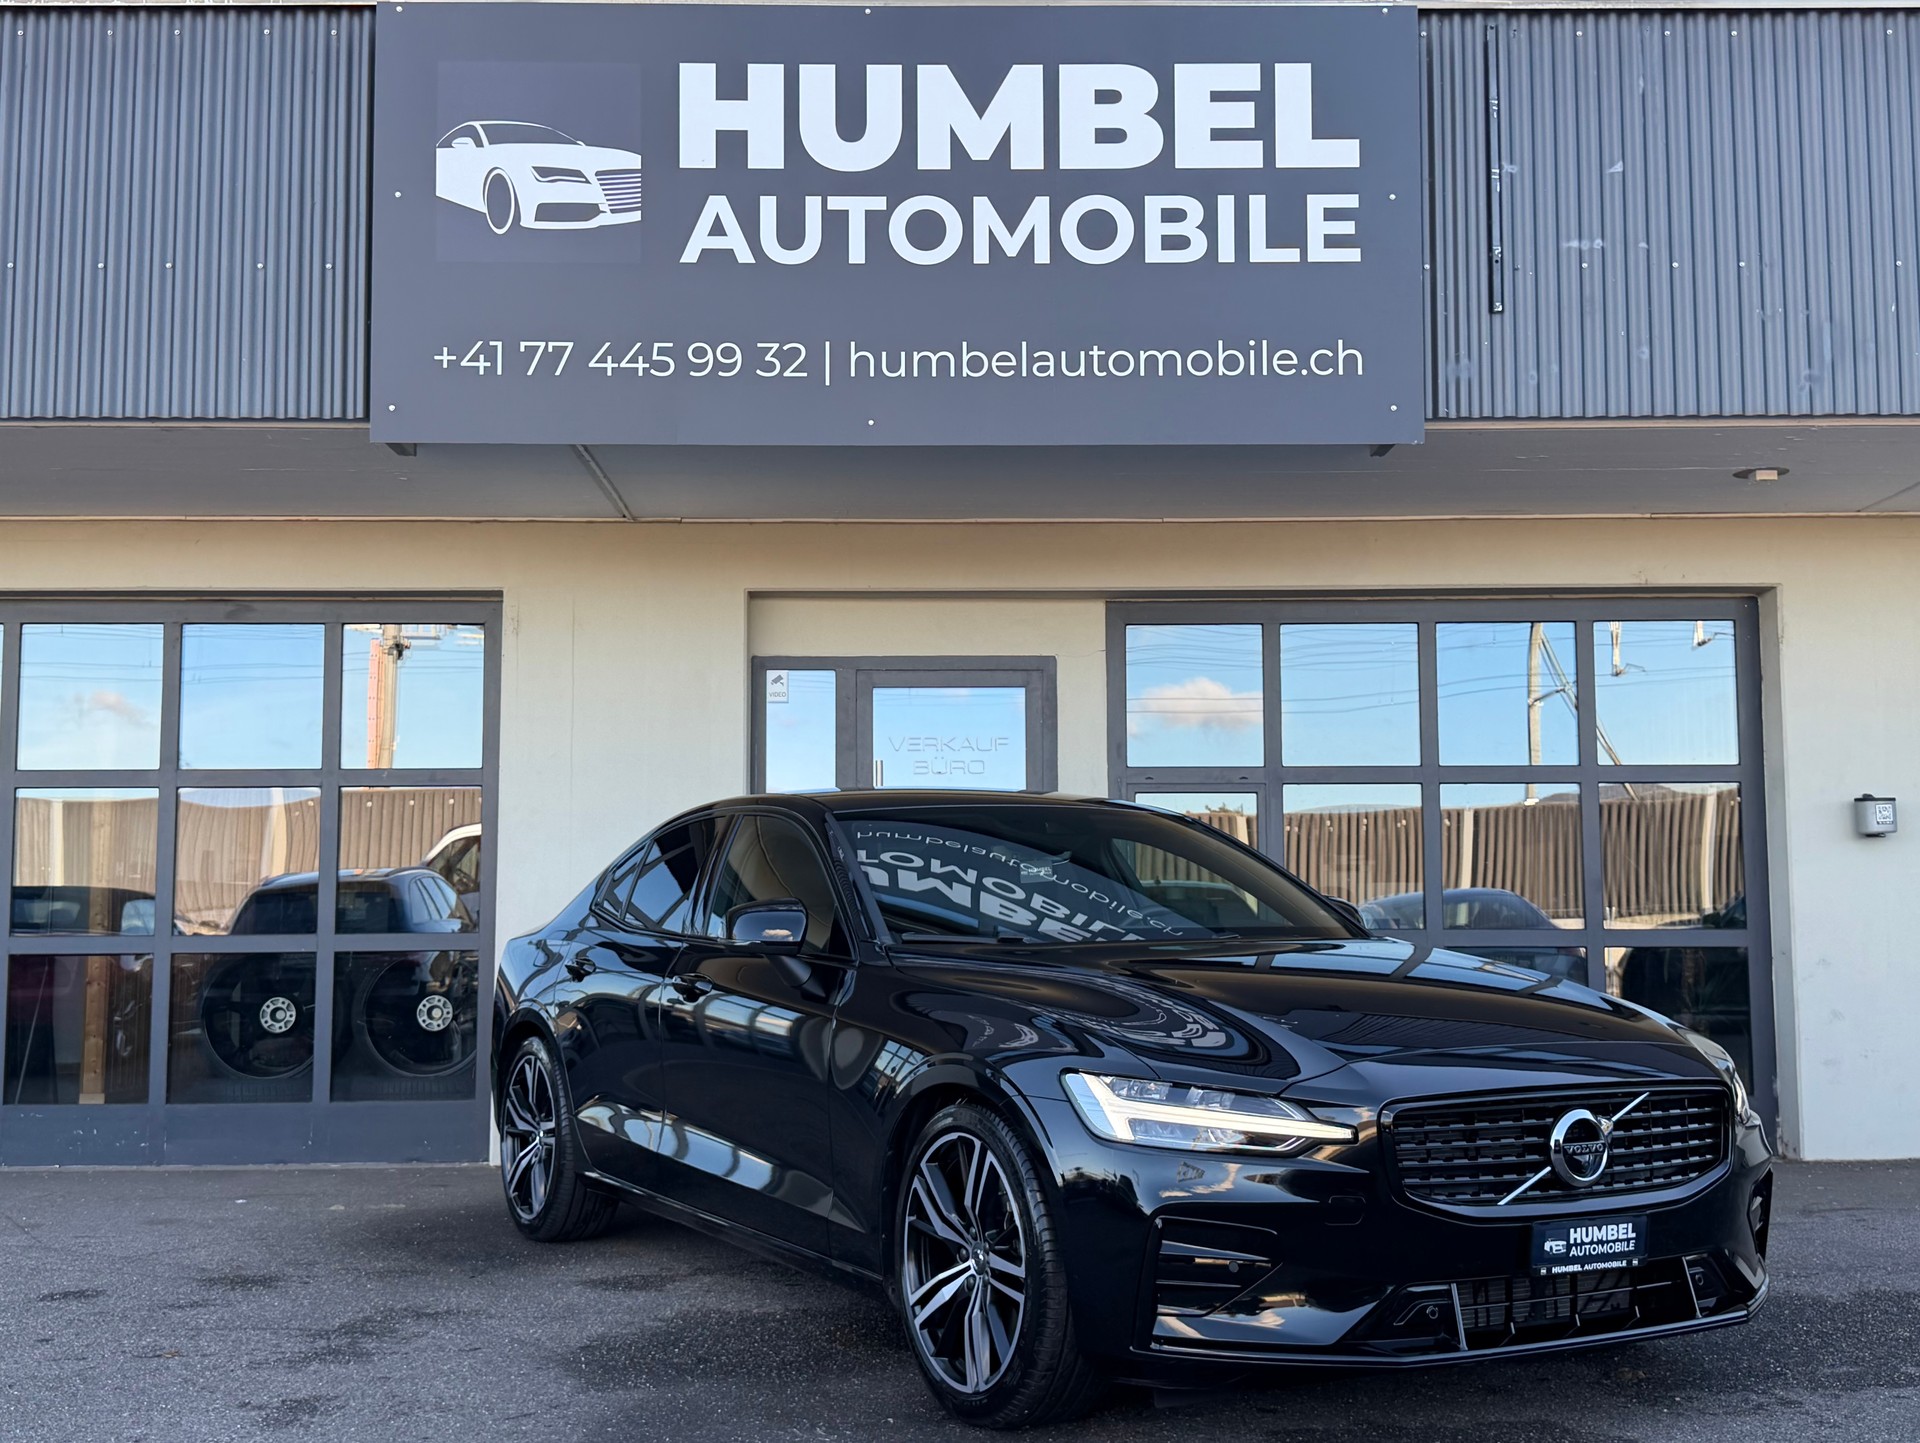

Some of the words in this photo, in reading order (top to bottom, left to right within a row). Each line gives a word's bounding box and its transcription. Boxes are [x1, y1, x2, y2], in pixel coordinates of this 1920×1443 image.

[678, 62, 1361, 171] HUMBEL
[679, 194, 1362, 266] AUTOMOBILE
[433, 340, 504, 376] +41
[519, 340, 574, 376] 77
[588, 341, 676, 377] 445
[688, 341, 743, 378] 99
[755, 342, 808, 378] 32
[849, 339, 1364, 379] humbelautomobile.ch
[888, 736, 1010, 752] VERKAUF
[913, 757, 985, 775] BÜRO
[1565, 1143, 1604, 1154] VOLVO
[1569, 1223, 1636, 1243] HUMBEL
[1569, 1240, 1635, 1256] AUTOMOBILE
[1551, 1263, 1583, 1274] HUMBEL
[1583, 1259, 1627, 1271] AUTOMOBILE
